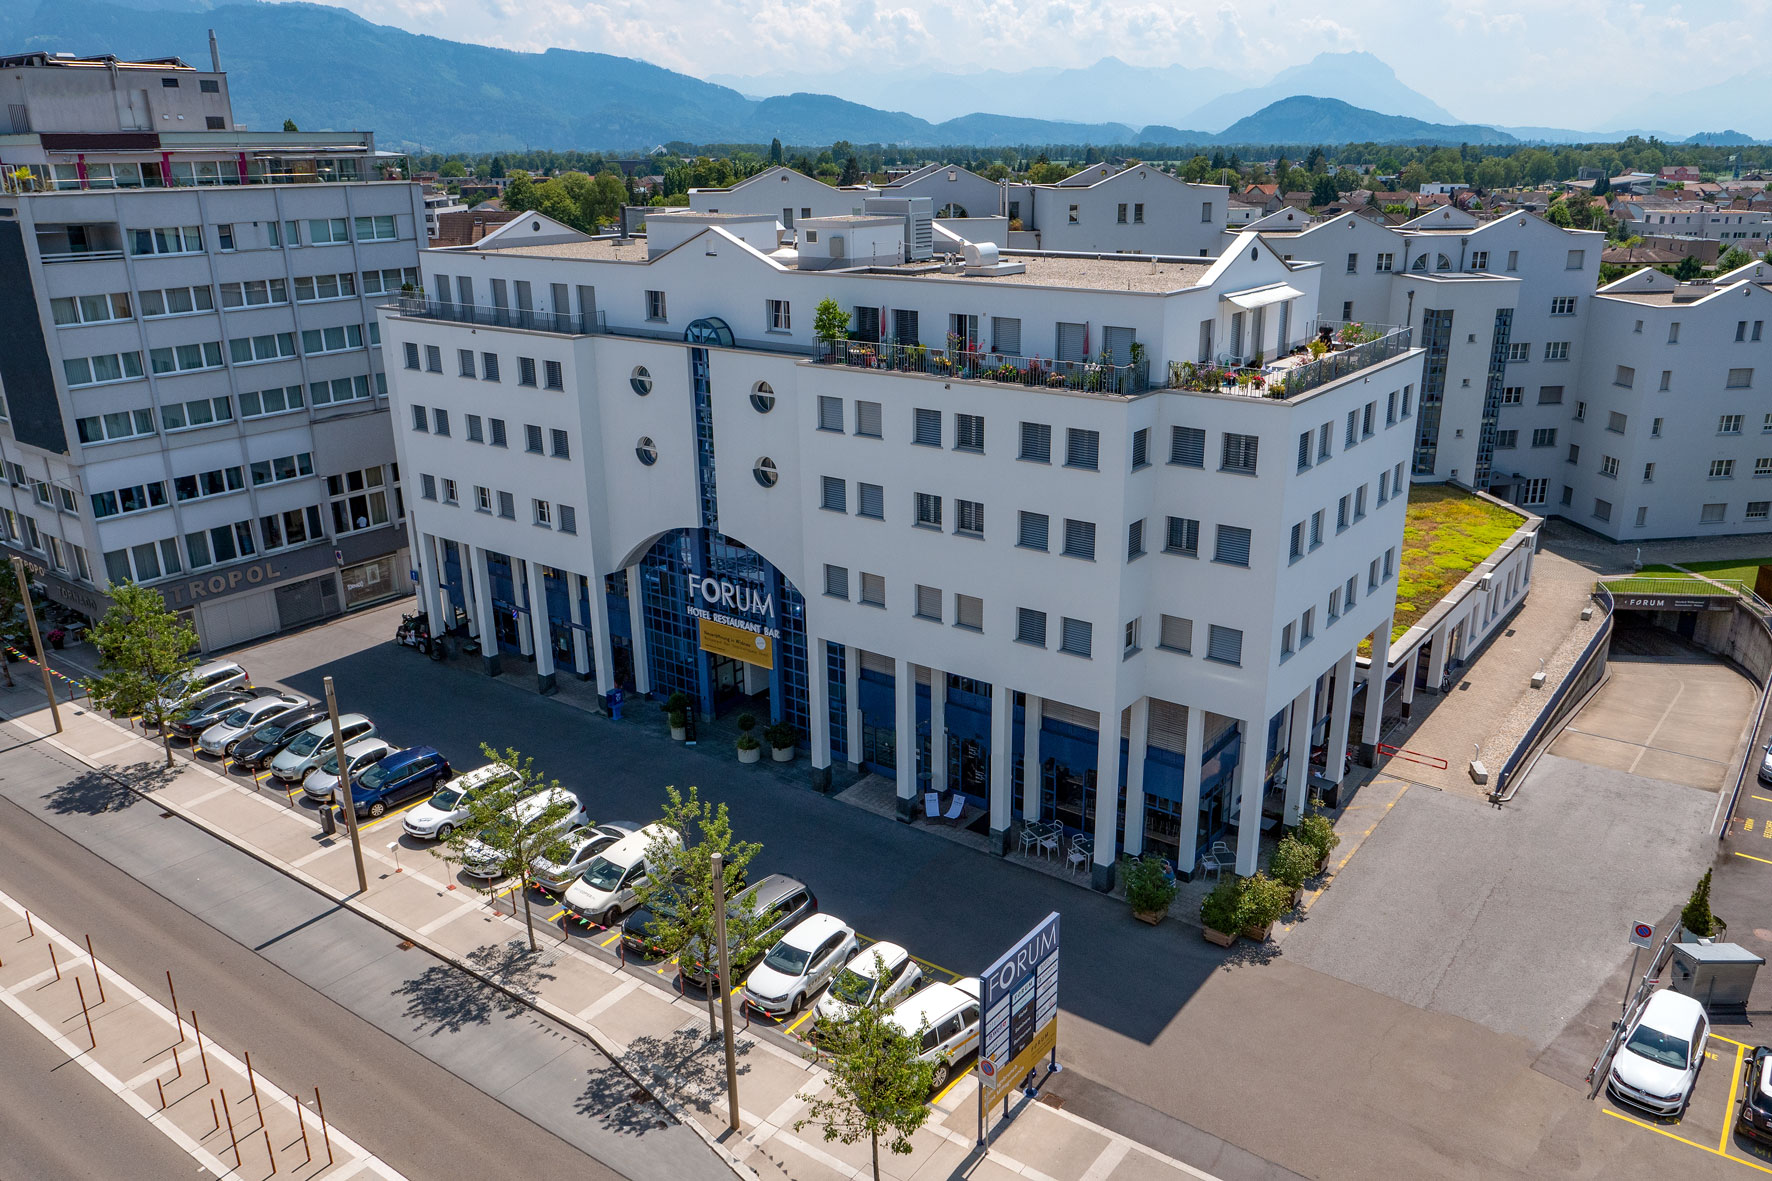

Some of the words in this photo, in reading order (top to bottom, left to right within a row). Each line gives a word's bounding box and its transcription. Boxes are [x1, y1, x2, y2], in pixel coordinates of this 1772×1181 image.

[688, 573, 775, 618] FORUM
[1629, 599, 1665, 607] FORUM
[686, 606, 712, 620] HOTEL
[712, 612, 761, 634] RESTAURANT
[763, 626, 781, 639] BAR
[989, 922, 1057, 1002] FORUM
